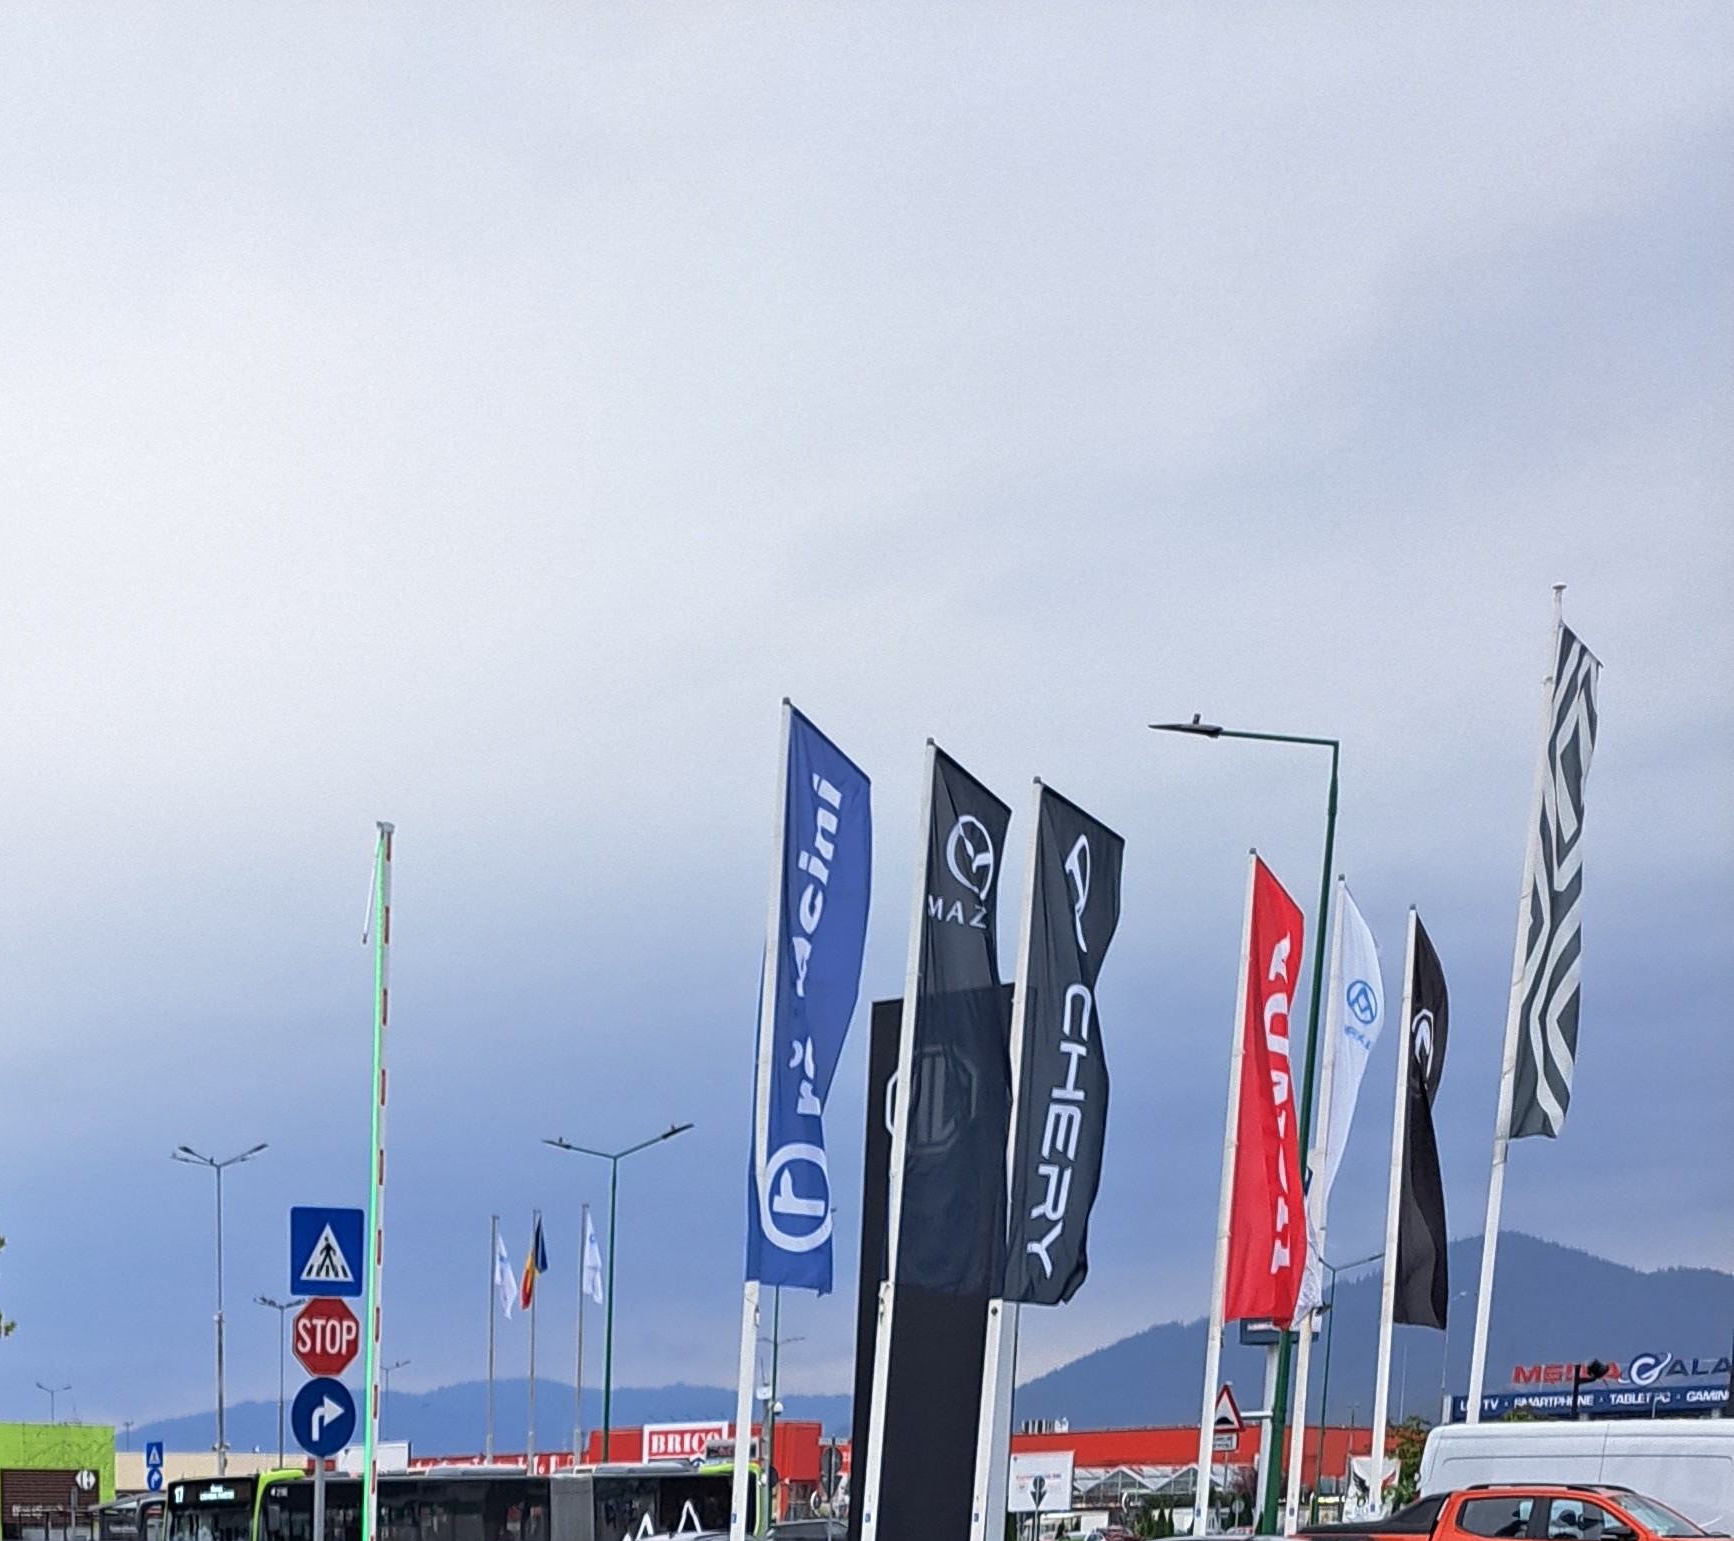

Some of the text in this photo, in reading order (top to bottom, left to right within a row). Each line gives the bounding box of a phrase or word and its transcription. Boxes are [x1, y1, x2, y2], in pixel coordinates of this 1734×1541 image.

[927, 893, 987, 929] MAZ
[1026, 983, 1092, 1280] CHERY
[297, 1318, 357, 1356] STOP
